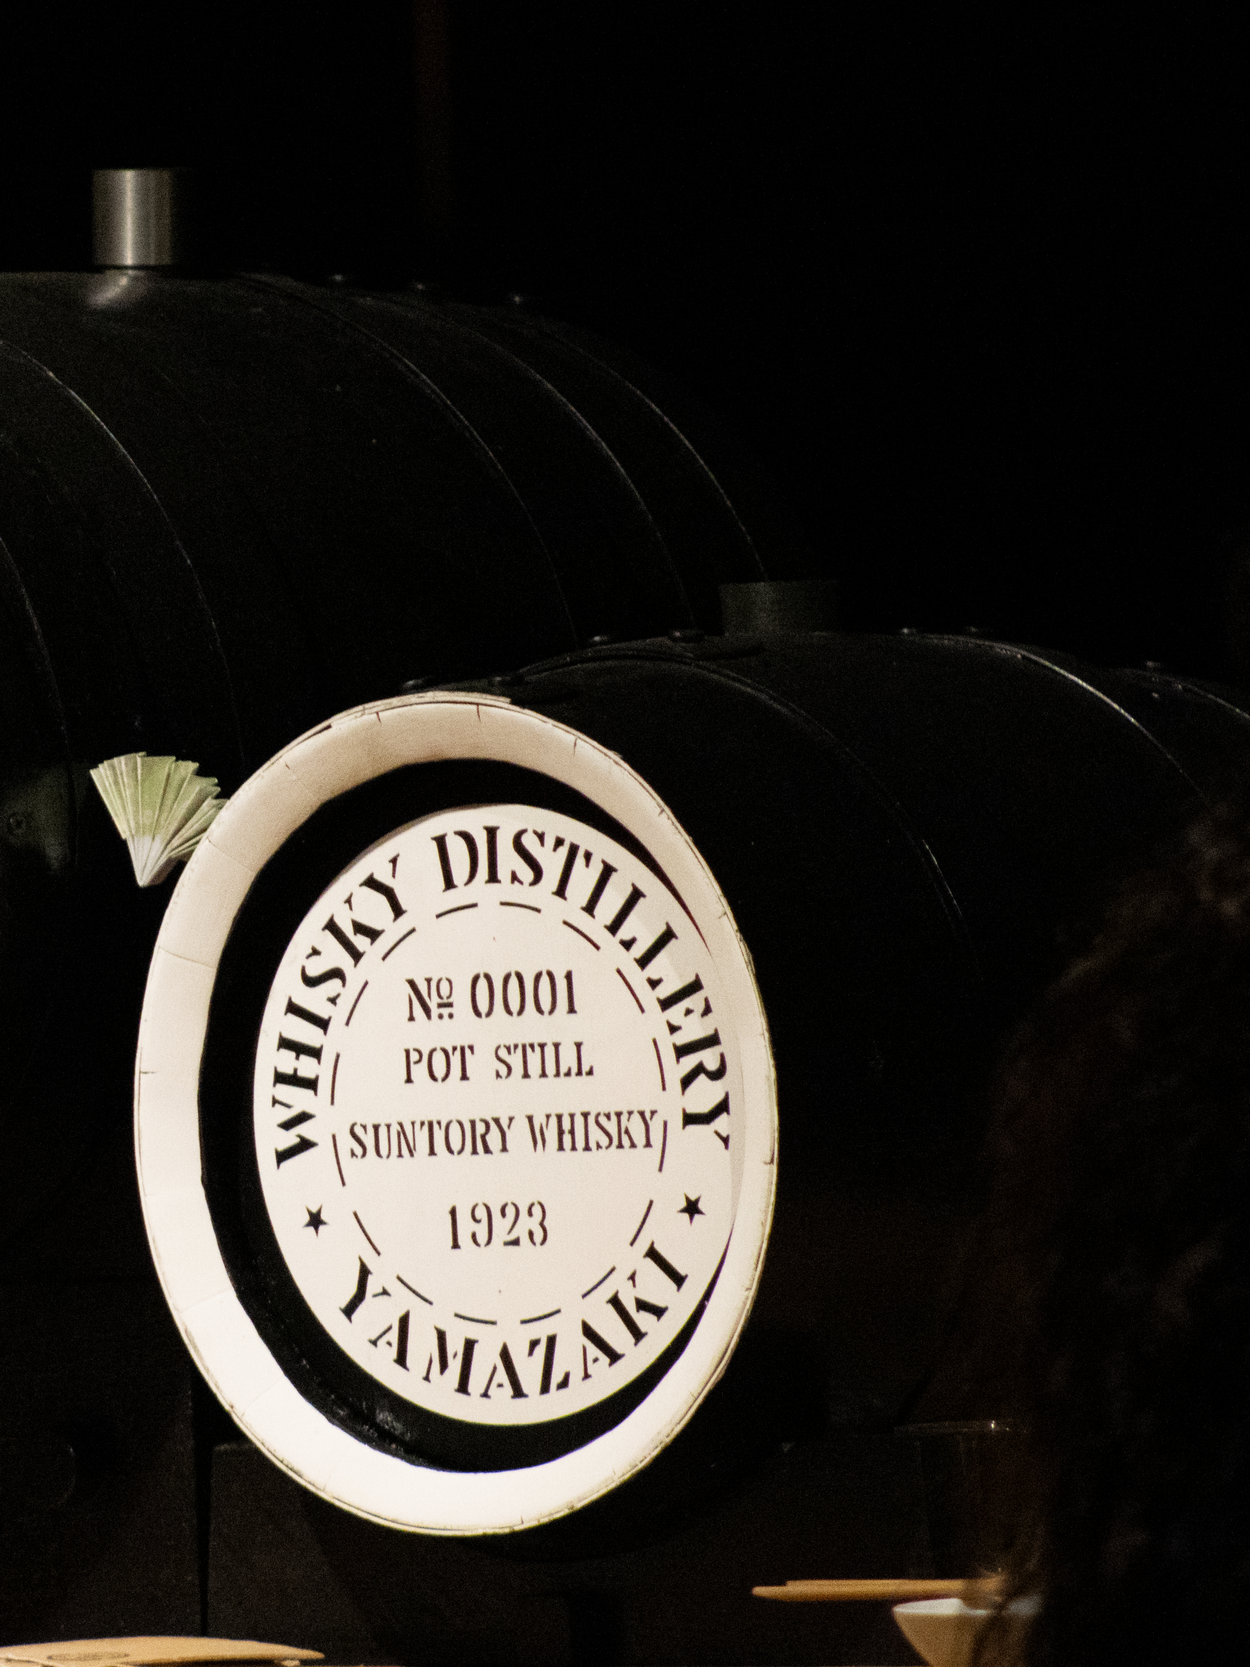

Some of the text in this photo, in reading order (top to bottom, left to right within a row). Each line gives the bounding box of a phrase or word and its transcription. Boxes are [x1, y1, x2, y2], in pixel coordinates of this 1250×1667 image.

[271, 826, 730, 1169] WHISKY DISTILLERY
[470, 969, 578, 1019] 0001
[404, 1041, 594, 1084] POT STILL
[349, 1109, 658, 1159] SUNTORY WHISKY
[448, 1201, 548, 1250] 1923
[338, 1240, 689, 1399] YAMAZAKI
